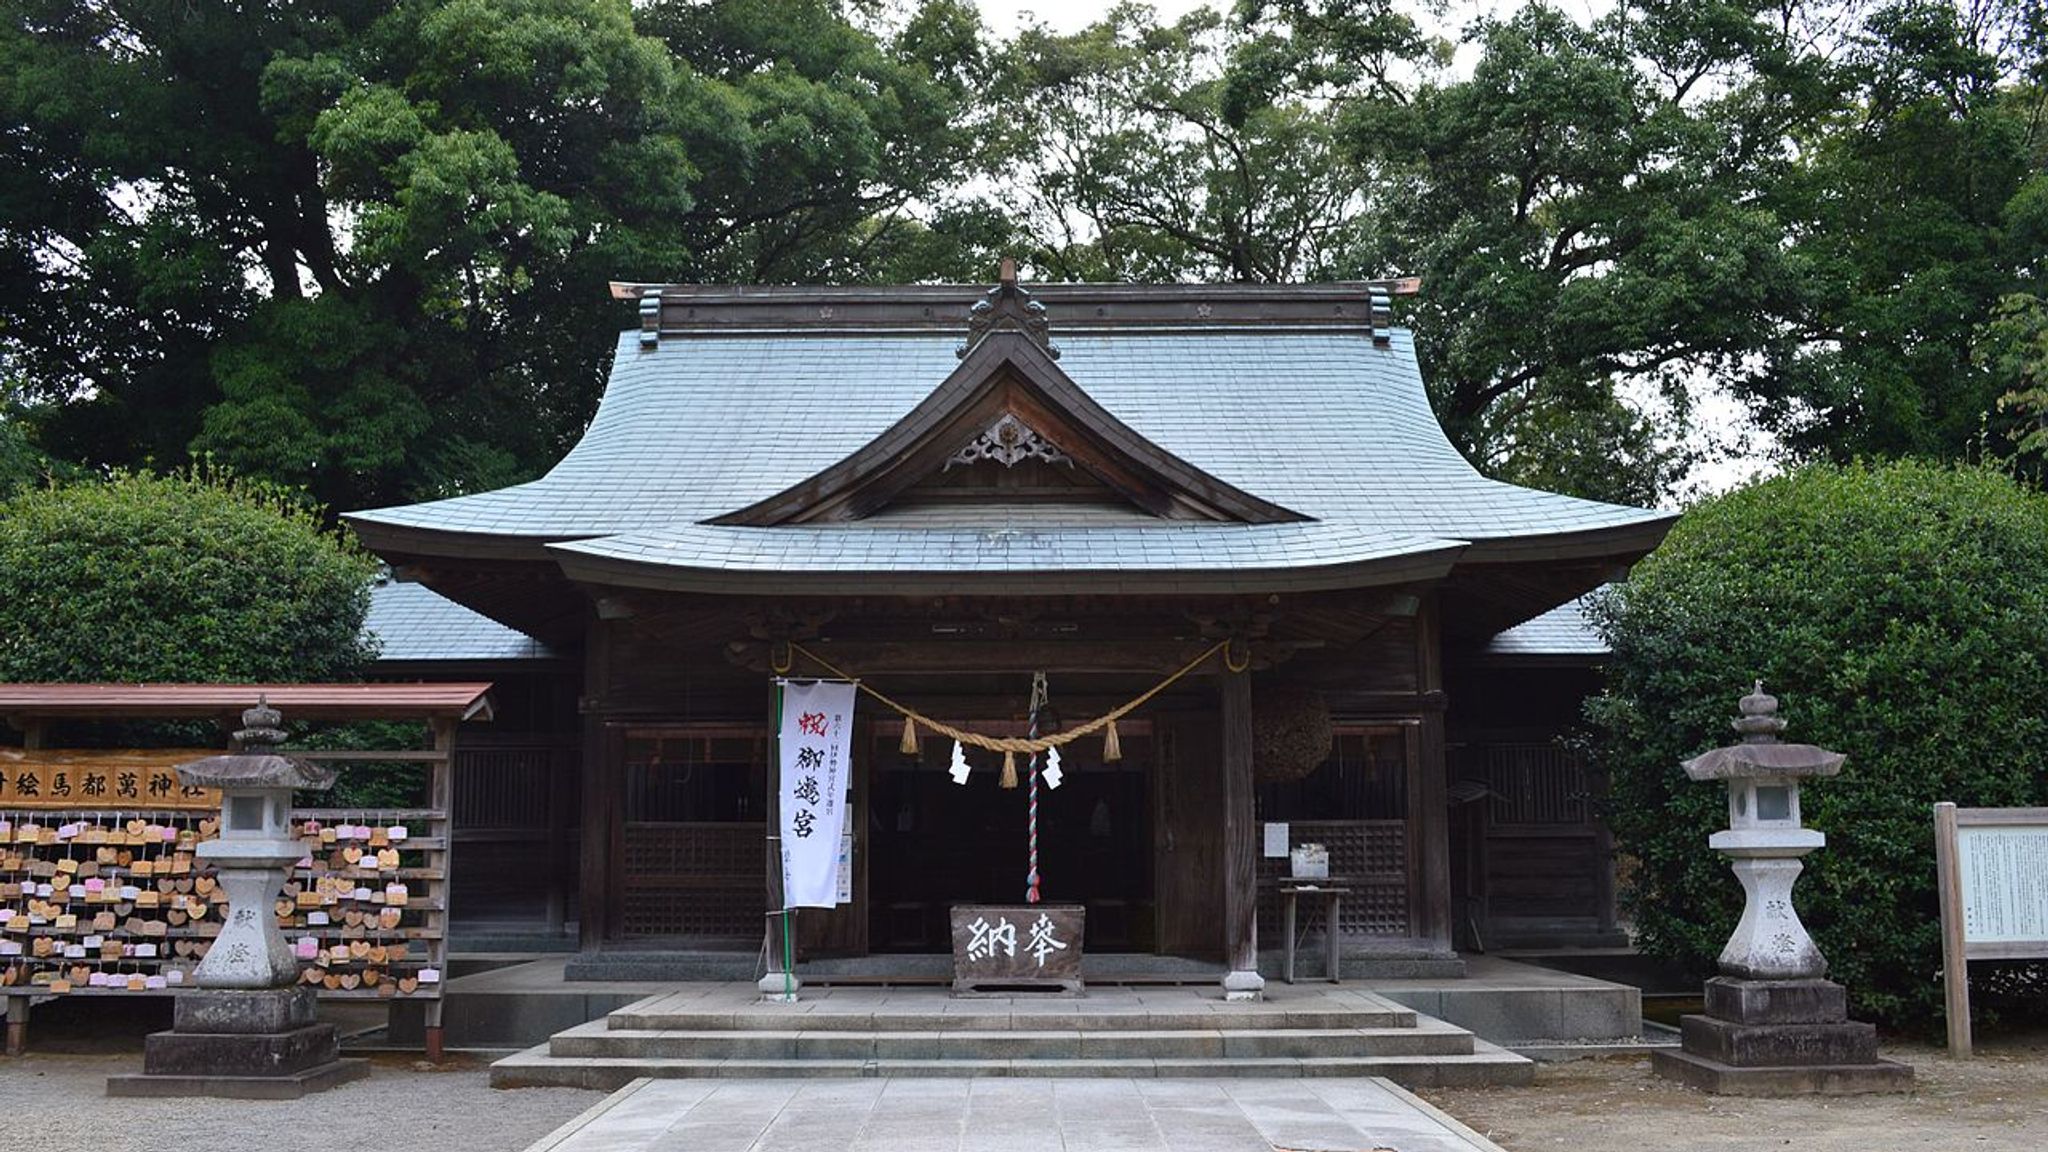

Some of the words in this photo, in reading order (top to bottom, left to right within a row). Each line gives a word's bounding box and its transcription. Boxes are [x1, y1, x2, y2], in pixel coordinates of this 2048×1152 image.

[0, 771, 205, 798] 絵馬都萬神
